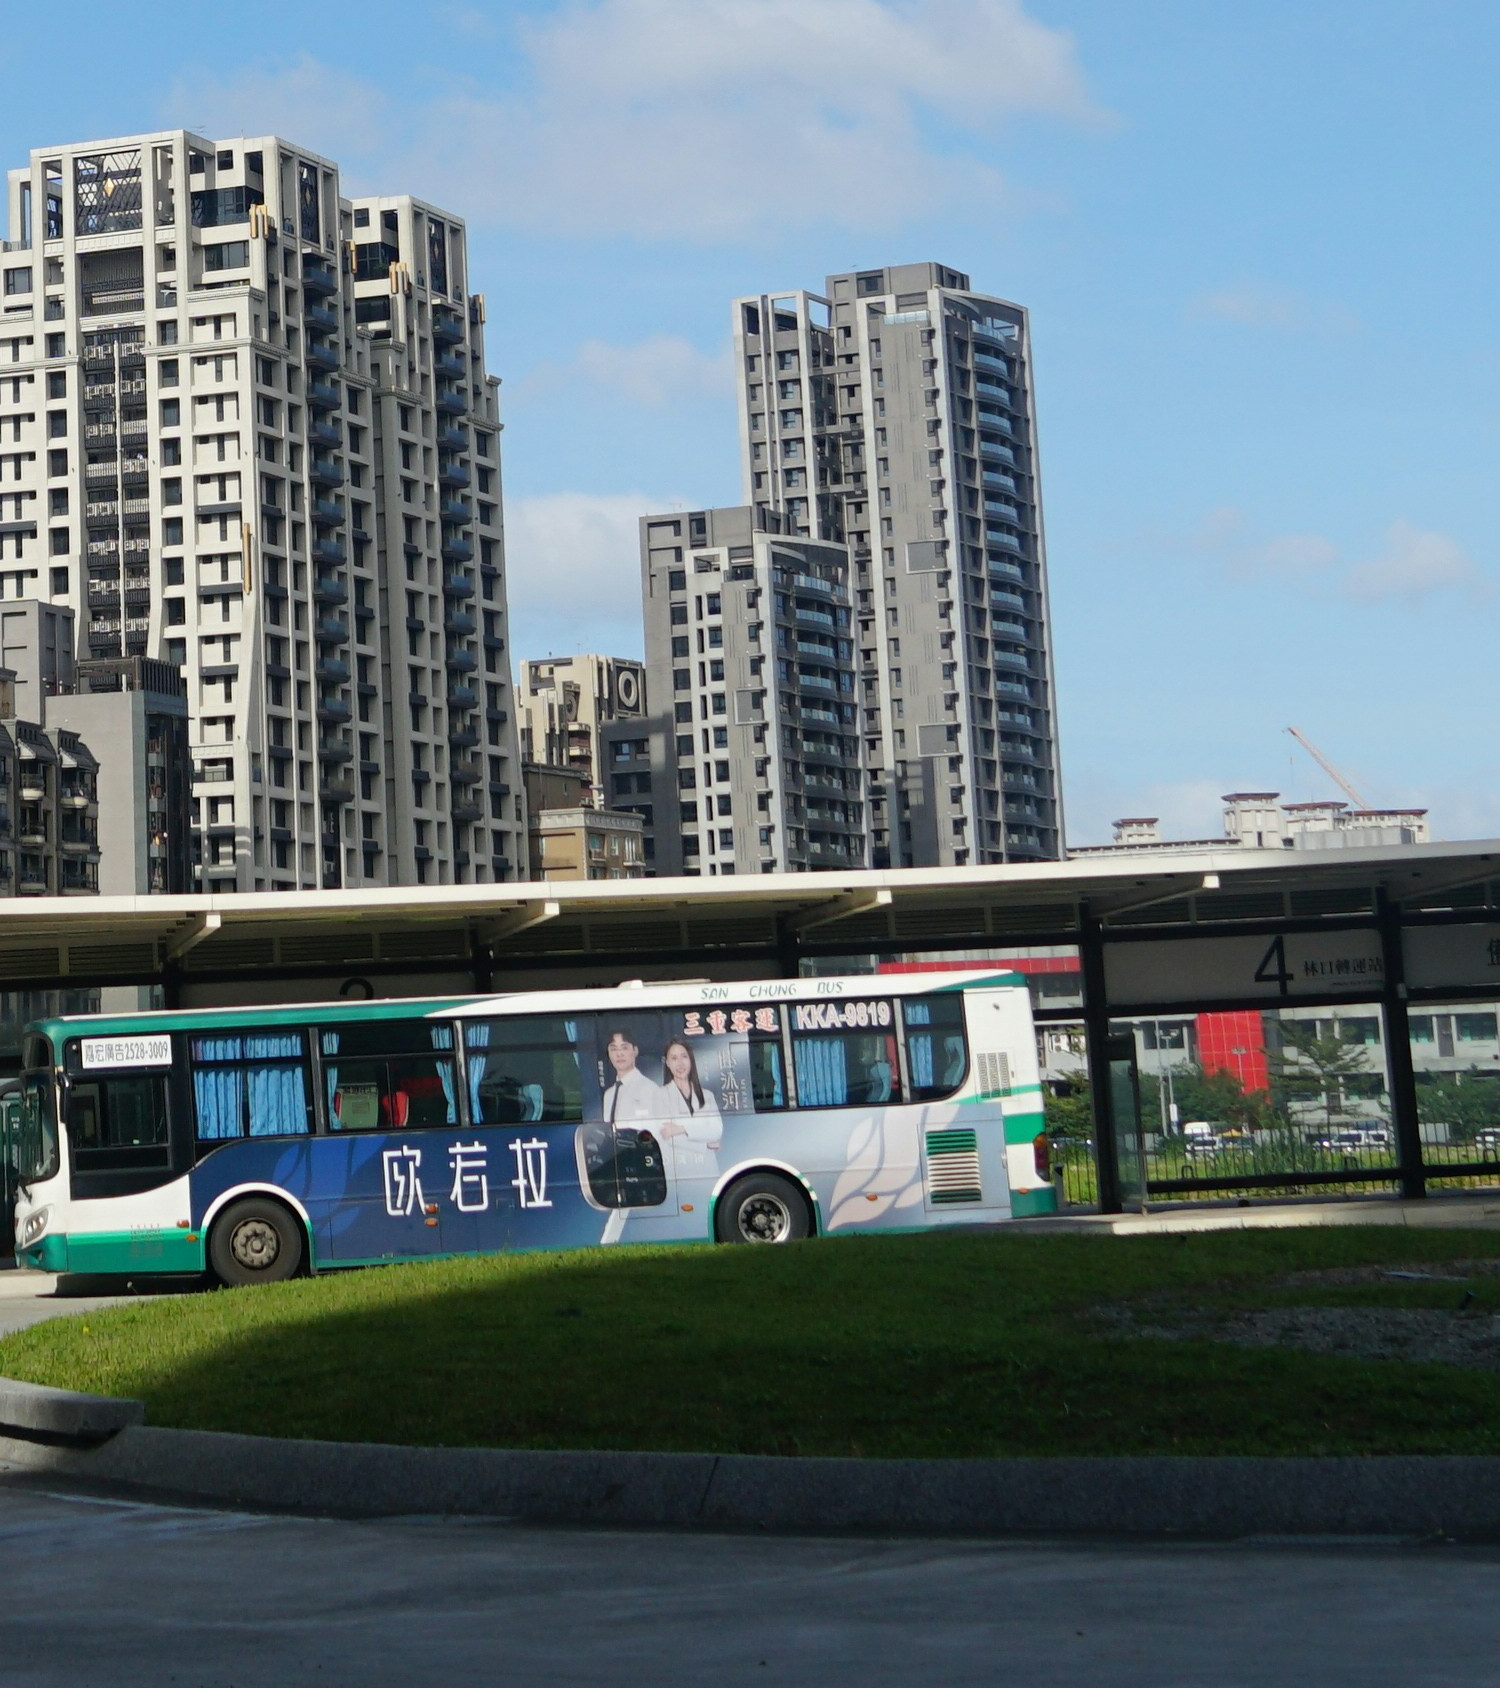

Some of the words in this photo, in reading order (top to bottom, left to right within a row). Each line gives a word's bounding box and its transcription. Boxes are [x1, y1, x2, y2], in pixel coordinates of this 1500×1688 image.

[1254, 935, 1293, 995] 4
[701, 987, 729, 1000] SAN
[749, 983, 797, 998] CHUNG
[817, 981, 844, 994] BUS
[683, 1007, 780, 1036] 三重客運
[795, 1000, 891, 1030] KKA-9819
